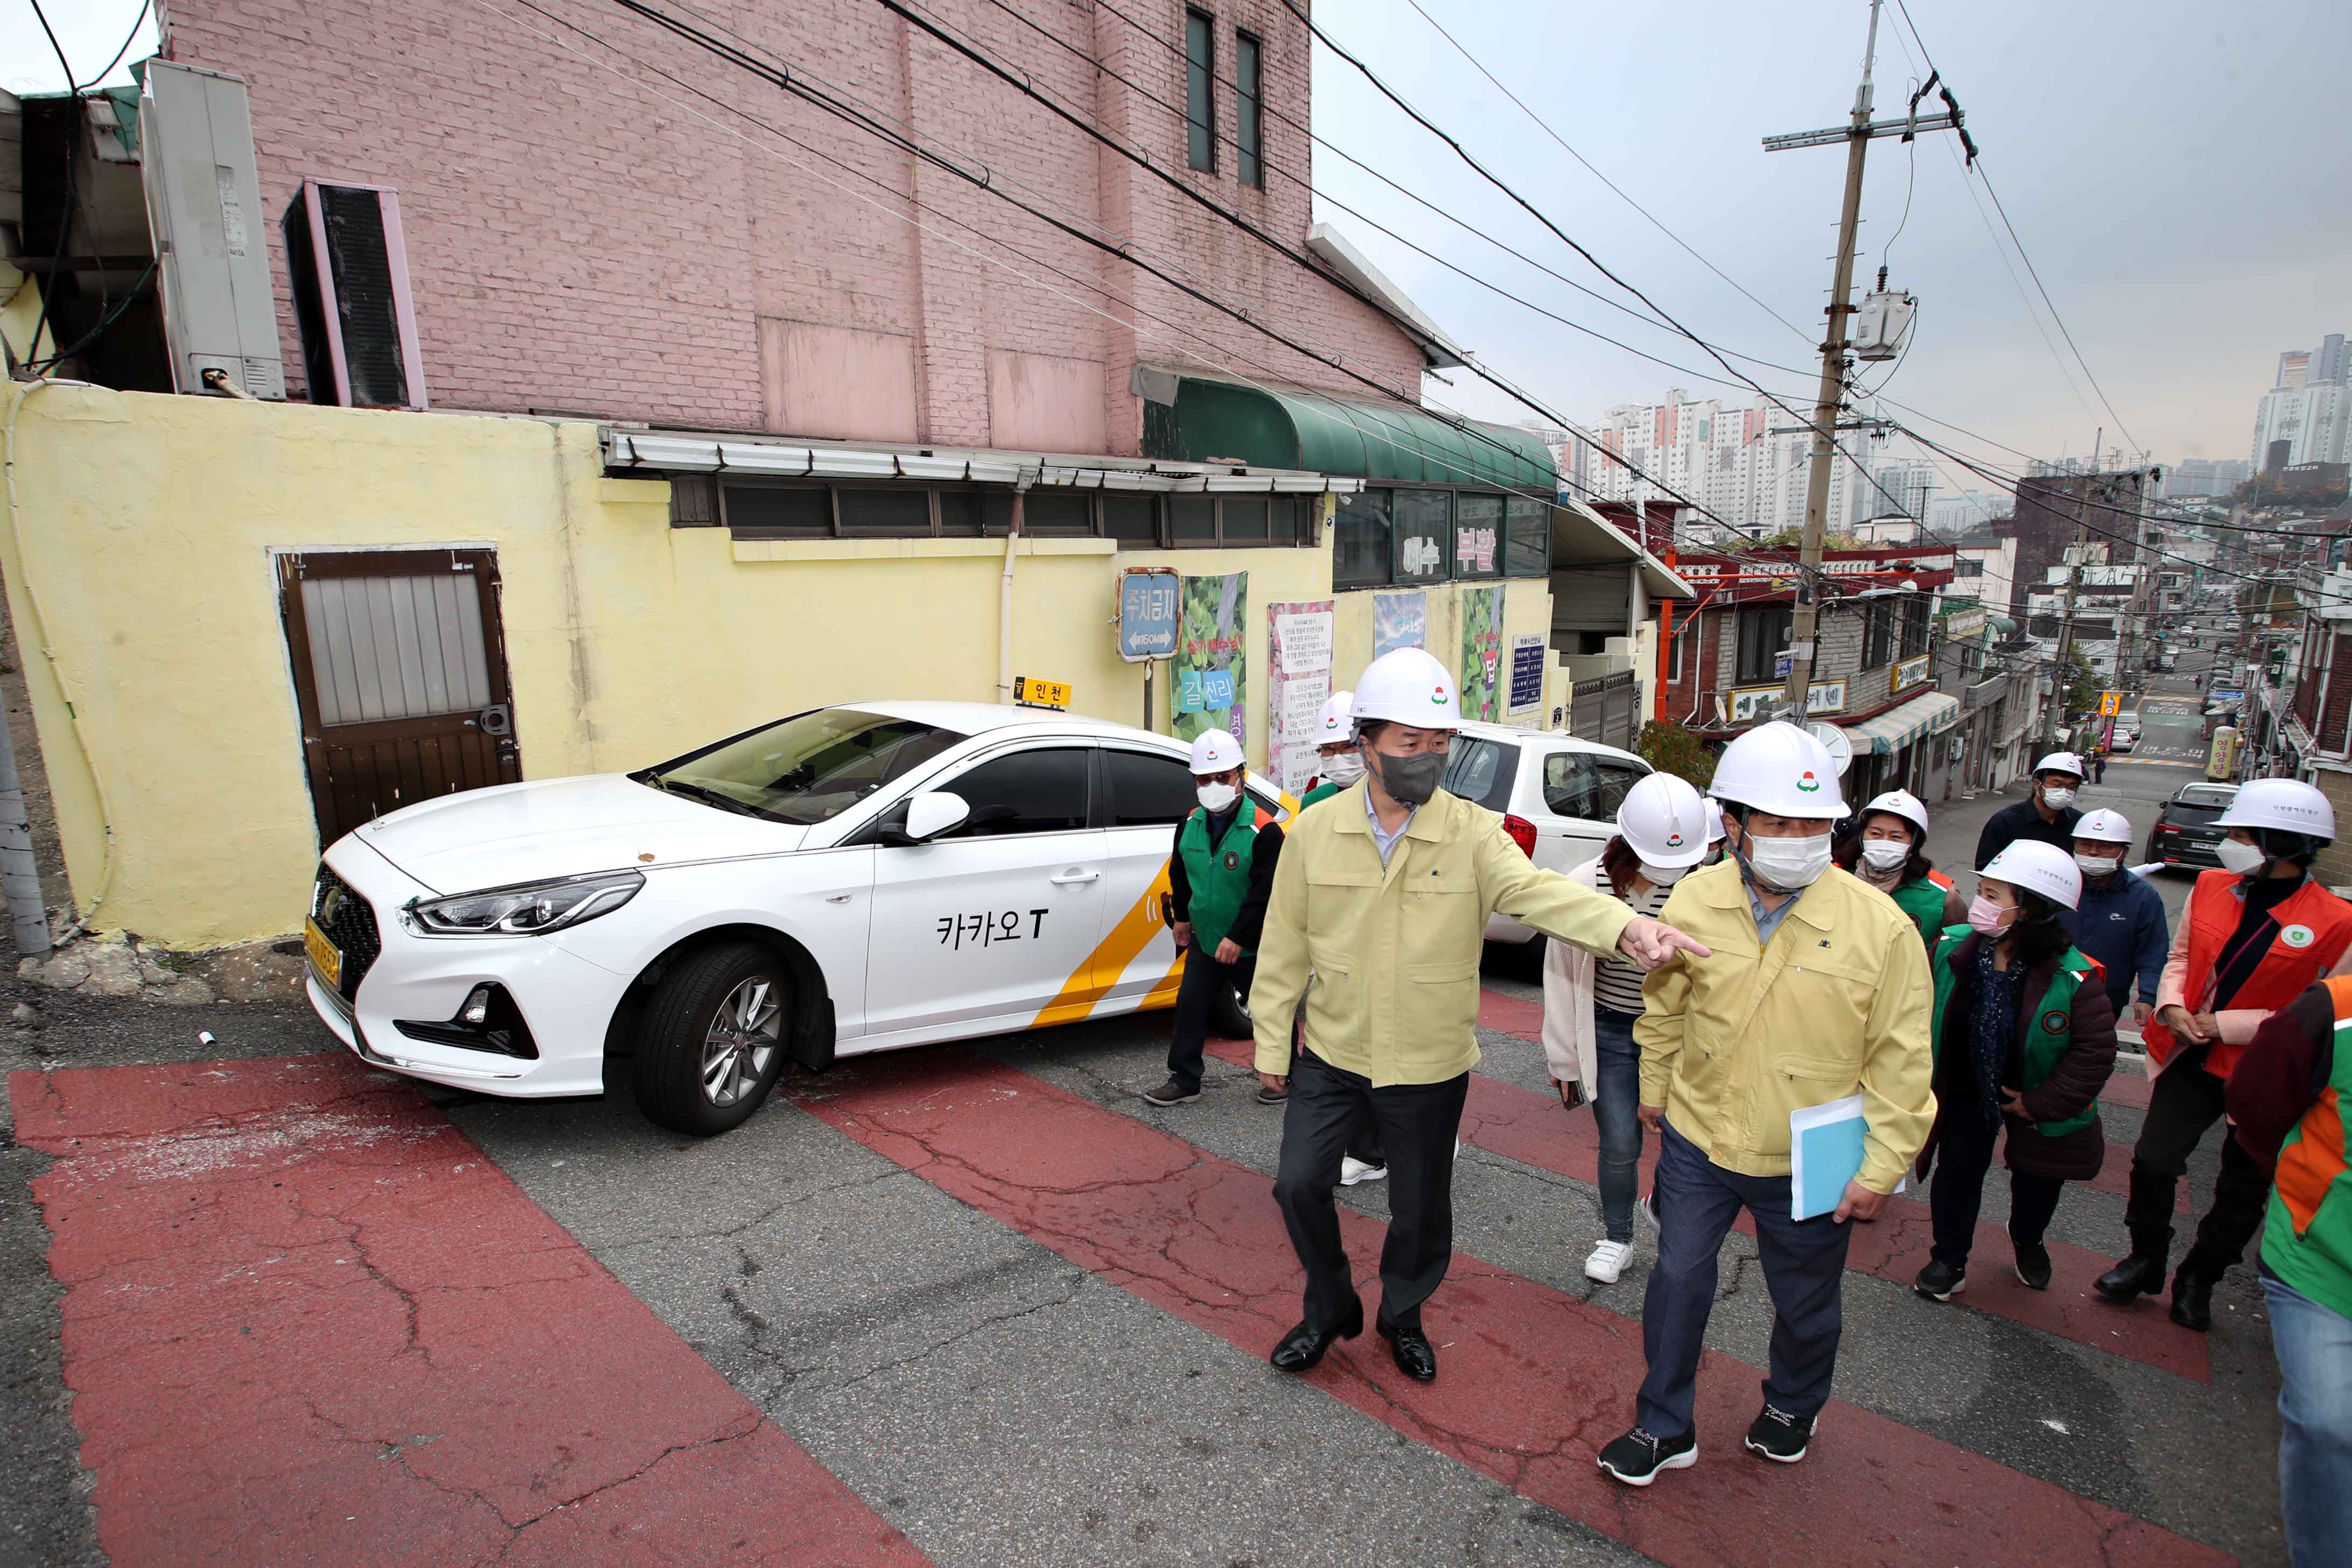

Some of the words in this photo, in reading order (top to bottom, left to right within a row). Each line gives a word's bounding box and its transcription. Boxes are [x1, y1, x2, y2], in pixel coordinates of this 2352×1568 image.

[1403, 536, 1440, 575] 예수
[1457, 527, 1496, 571] 부활
[1036, 684, 1061, 701] 인천
[1185, 680, 1201, 705] 길
[1206, 678, 1233, 703] 진리
[2214, 740, 2228, 774] 영양탕
[936, 911, 1021, 951] 카카오
[1029, 908, 1049, 939] T
